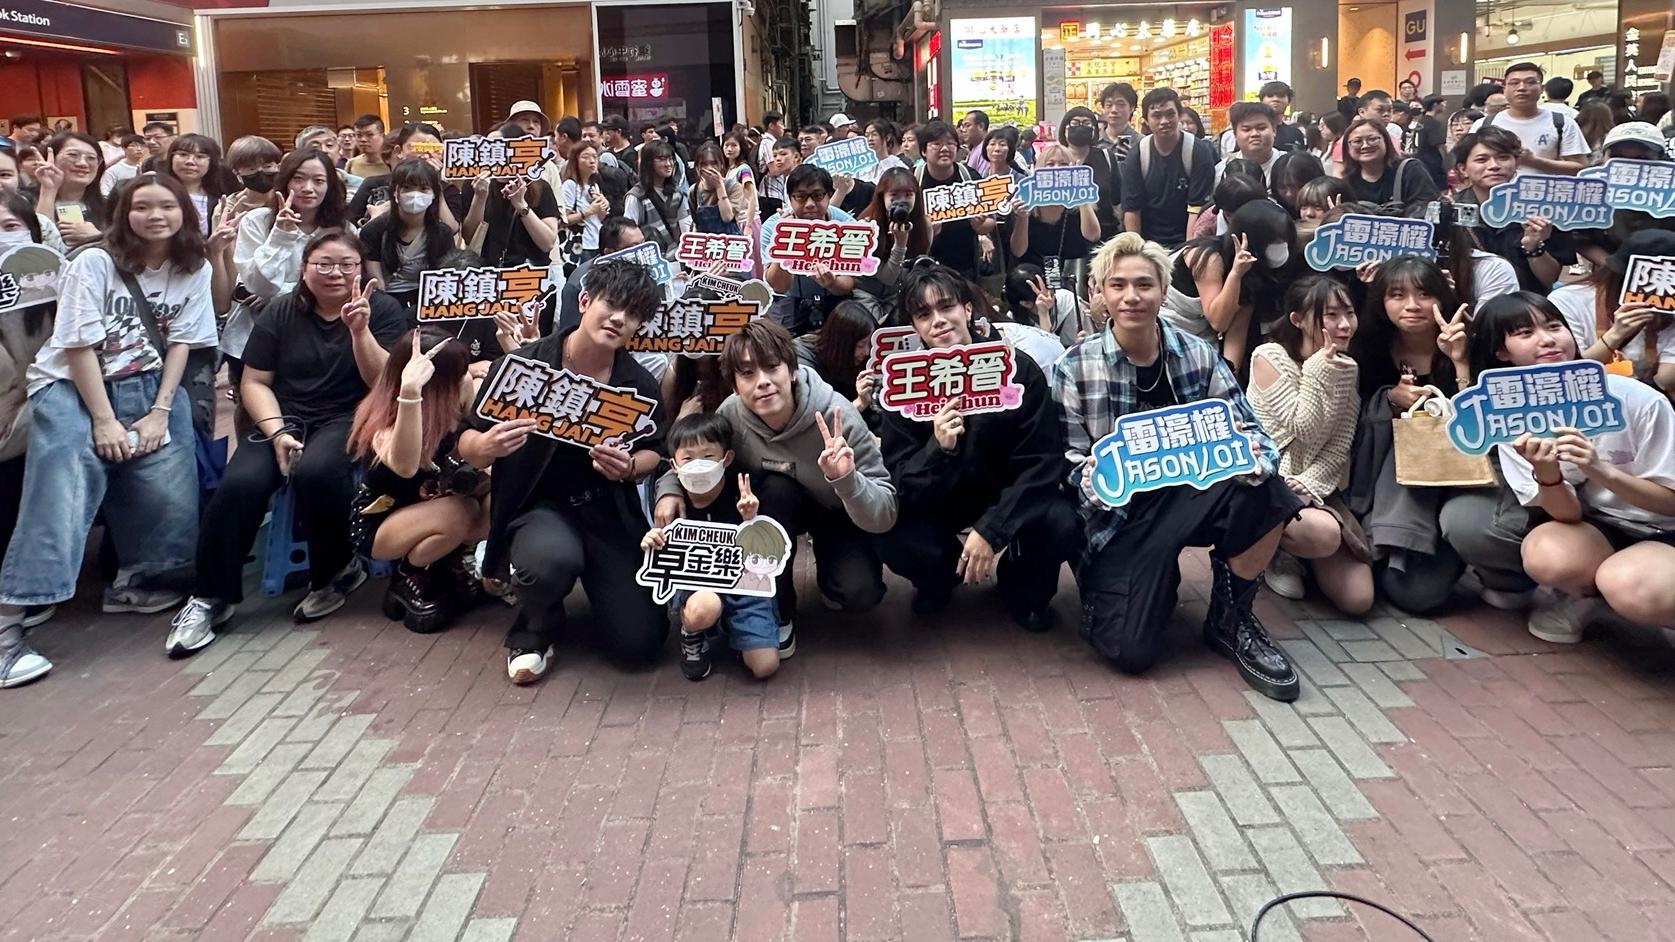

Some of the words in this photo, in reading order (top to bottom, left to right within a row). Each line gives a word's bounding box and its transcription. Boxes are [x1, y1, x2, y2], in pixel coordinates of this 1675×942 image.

[10, 10, 51, 26] Station
[1406, 19, 1425, 35] GU
[403, 106, 410, 116] 3
[446, 138, 547, 174] 陳鎮亨
[491, 165, 516, 176] JAI
[927, 177, 1013, 211] 陳鎮亨
[929, 207, 966, 221] HANG
[967, 203, 993, 217] JAI
[822, 260, 861, 273] hun
[424, 267, 547, 308] 陳鎮亨
[1630, 260, 1675, 297] 陳
[420, 304, 477, 319] HANG
[478, 302, 511, 316] JAI
[624, 337, 687, 352] HANG
[687, 337, 716, 352] JAI
[493, 361, 652, 445] 陳鎮亨
[955, 393, 1001, 411] hun
[481, 398, 553, 432] HANG
[551, 418, 593, 442] JAI
[673, 526, 698, 542] KIM
[698, 529, 736, 545] CHEUK
